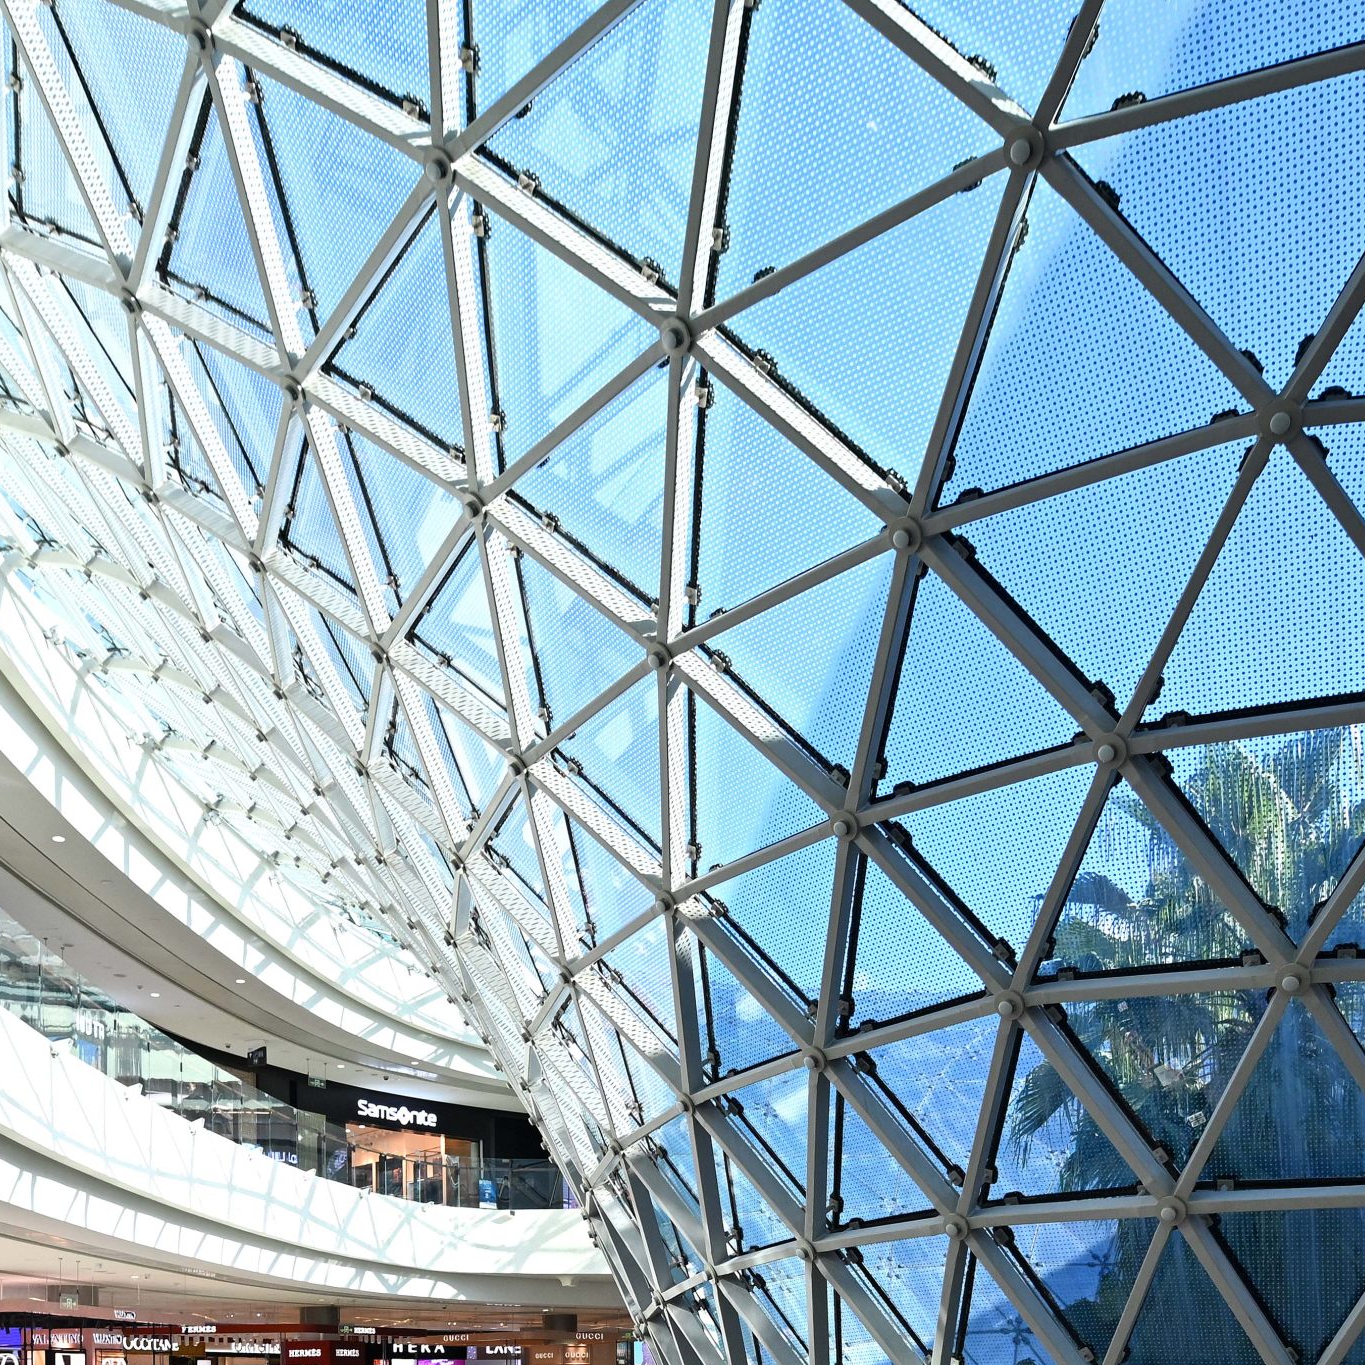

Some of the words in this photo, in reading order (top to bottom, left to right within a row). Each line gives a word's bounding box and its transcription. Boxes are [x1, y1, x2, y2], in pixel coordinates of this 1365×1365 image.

[443, 1334, 469, 1342] GUCCI
[575, 1332, 604, 1341] GUCCI
[535, 1352, 554, 1360] GUCCI
